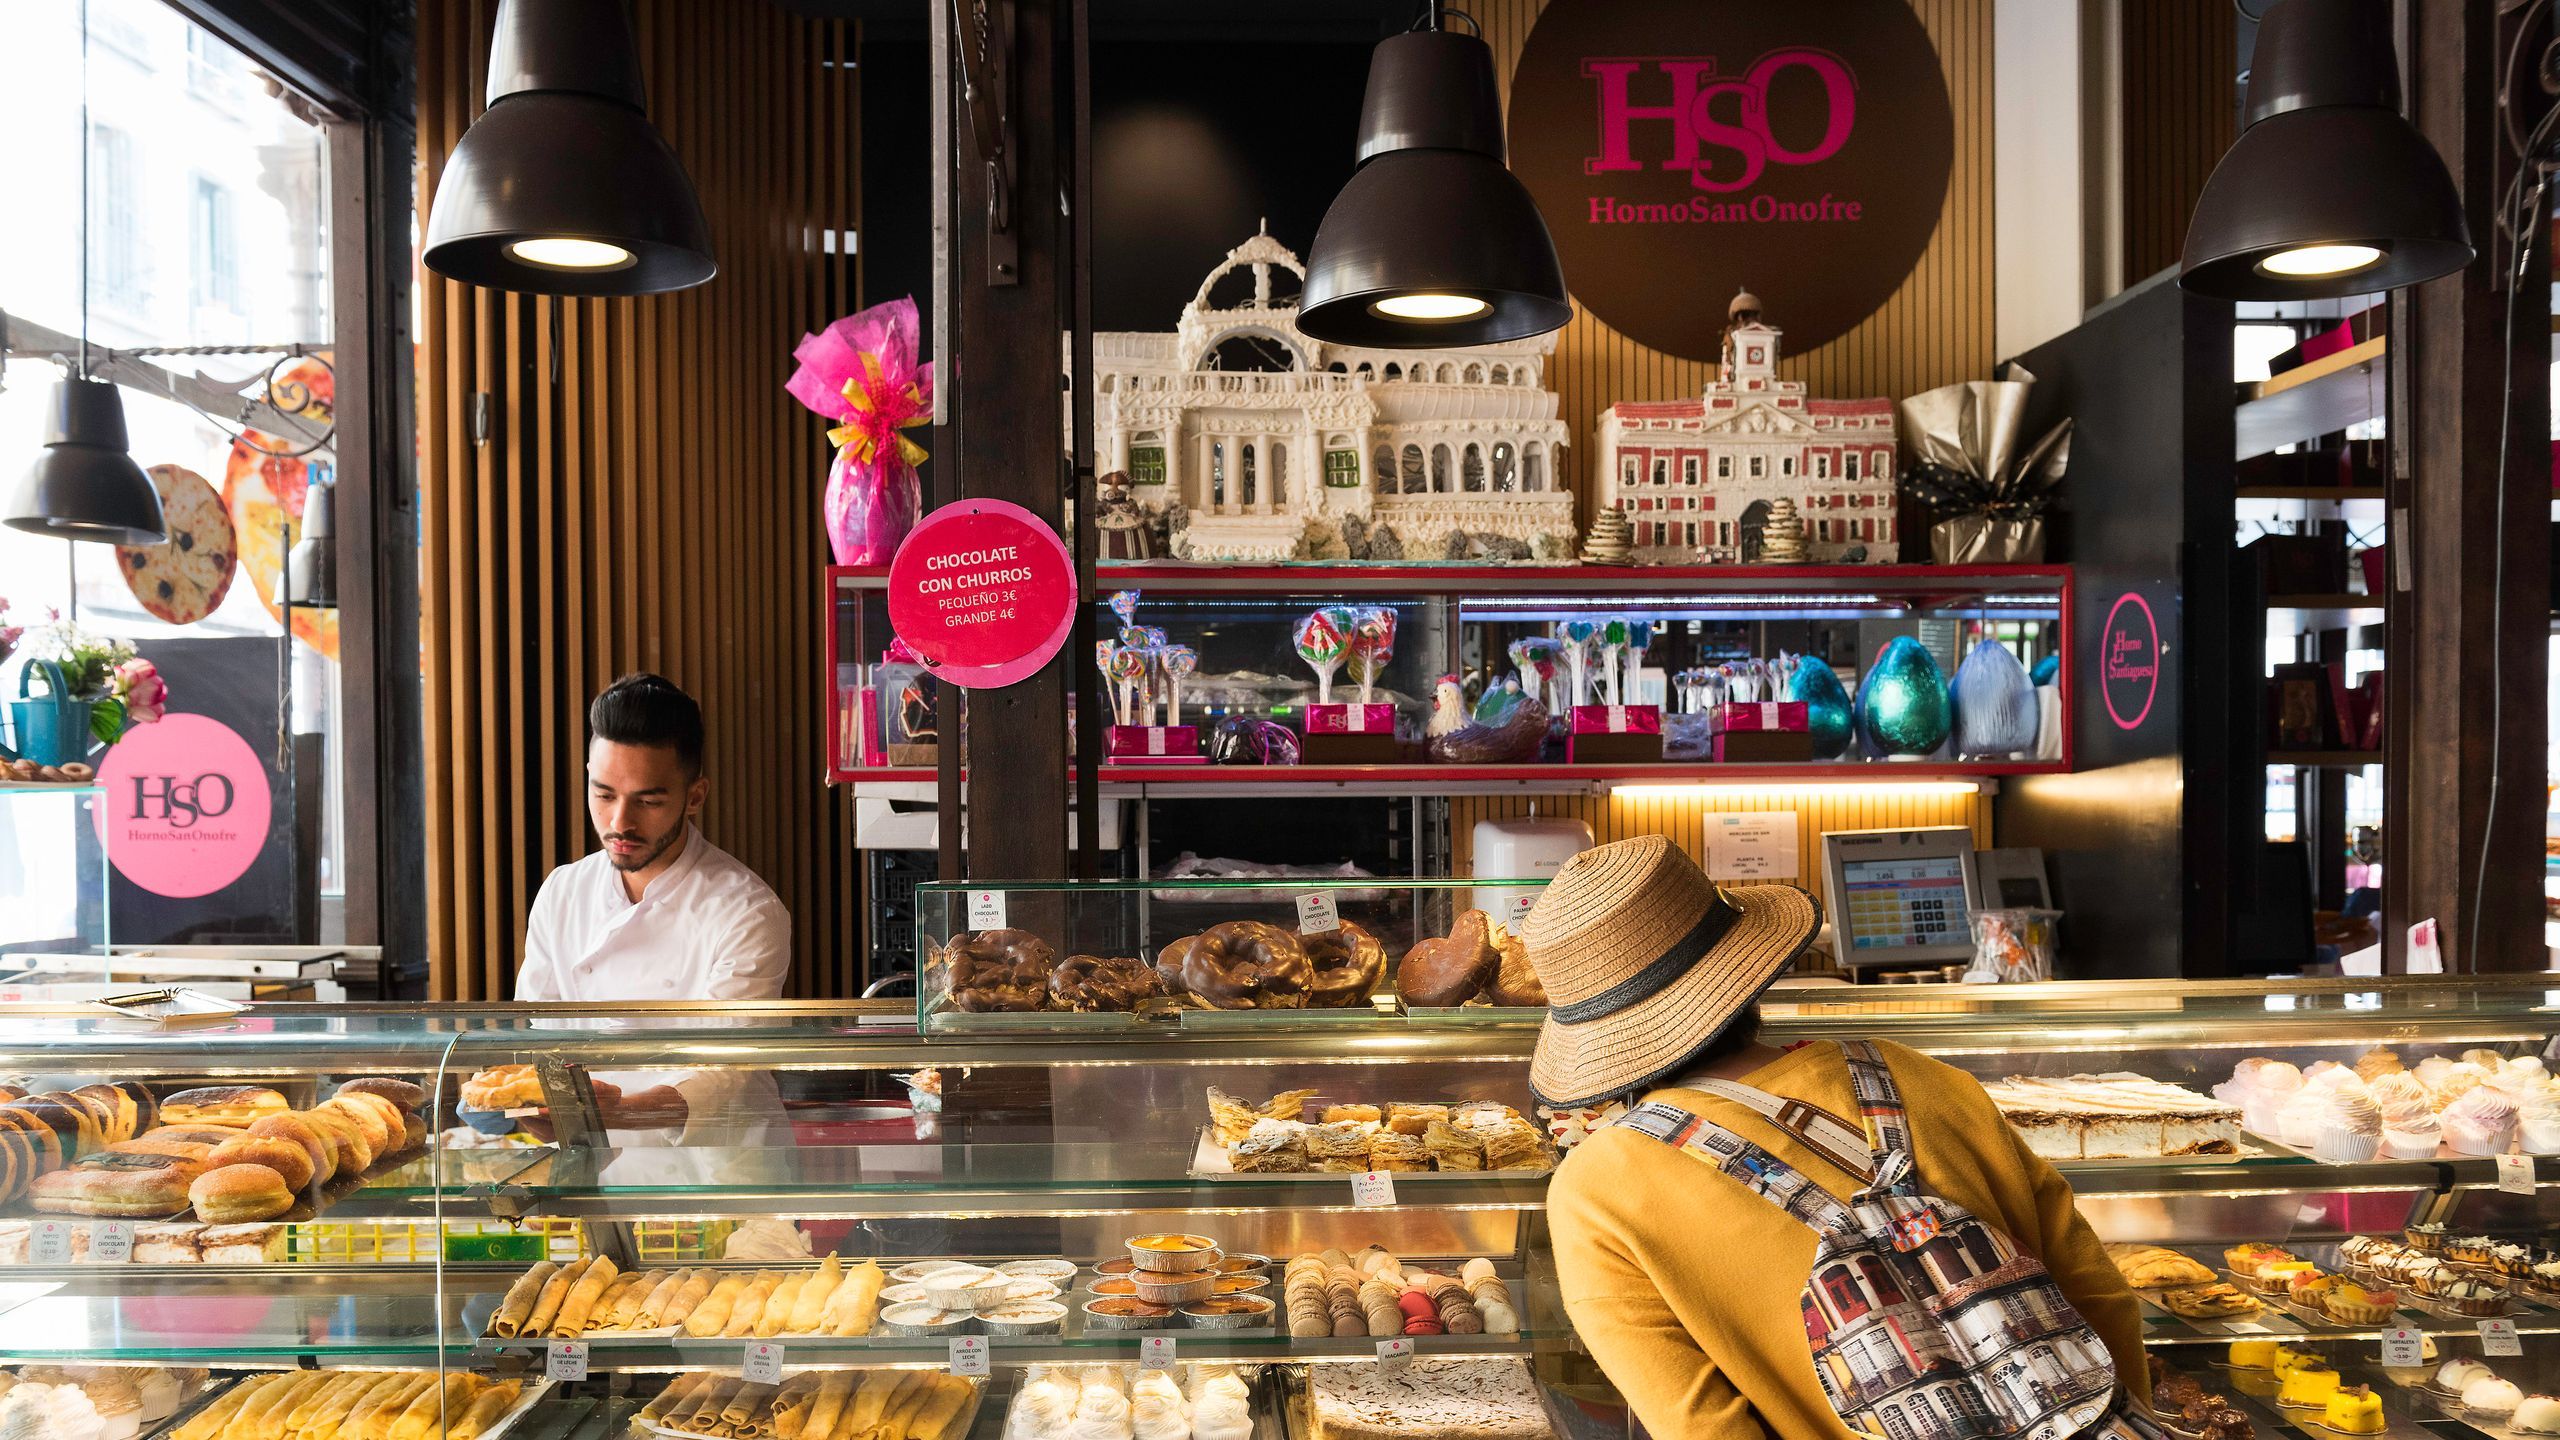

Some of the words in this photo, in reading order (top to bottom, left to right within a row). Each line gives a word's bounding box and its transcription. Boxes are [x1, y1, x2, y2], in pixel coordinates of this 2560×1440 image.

[1582, 46, 1859, 192] HSO
[1587, 194, 1862, 224] HornoSanOnofre
[926, 546, 1018, 571] CHOCOLATE
[918, 577, 953, 594] CON
[956, 566, 1032, 589] CHURROS
[938, 592, 999, 610] PEQUEÑO
[1001, 589, 1018, 602] 3€
[945, 610, 997, 627] GRANDE
[999, 607, 1016, 620] 4€
[130, 773, 234, 828] HSO
[128, 829, 237, 841] HornoSanOnofre
[1305, 911, 1330, 920] CHOCOLATE
[1385, 1351, 1410, 1359] MACARON
